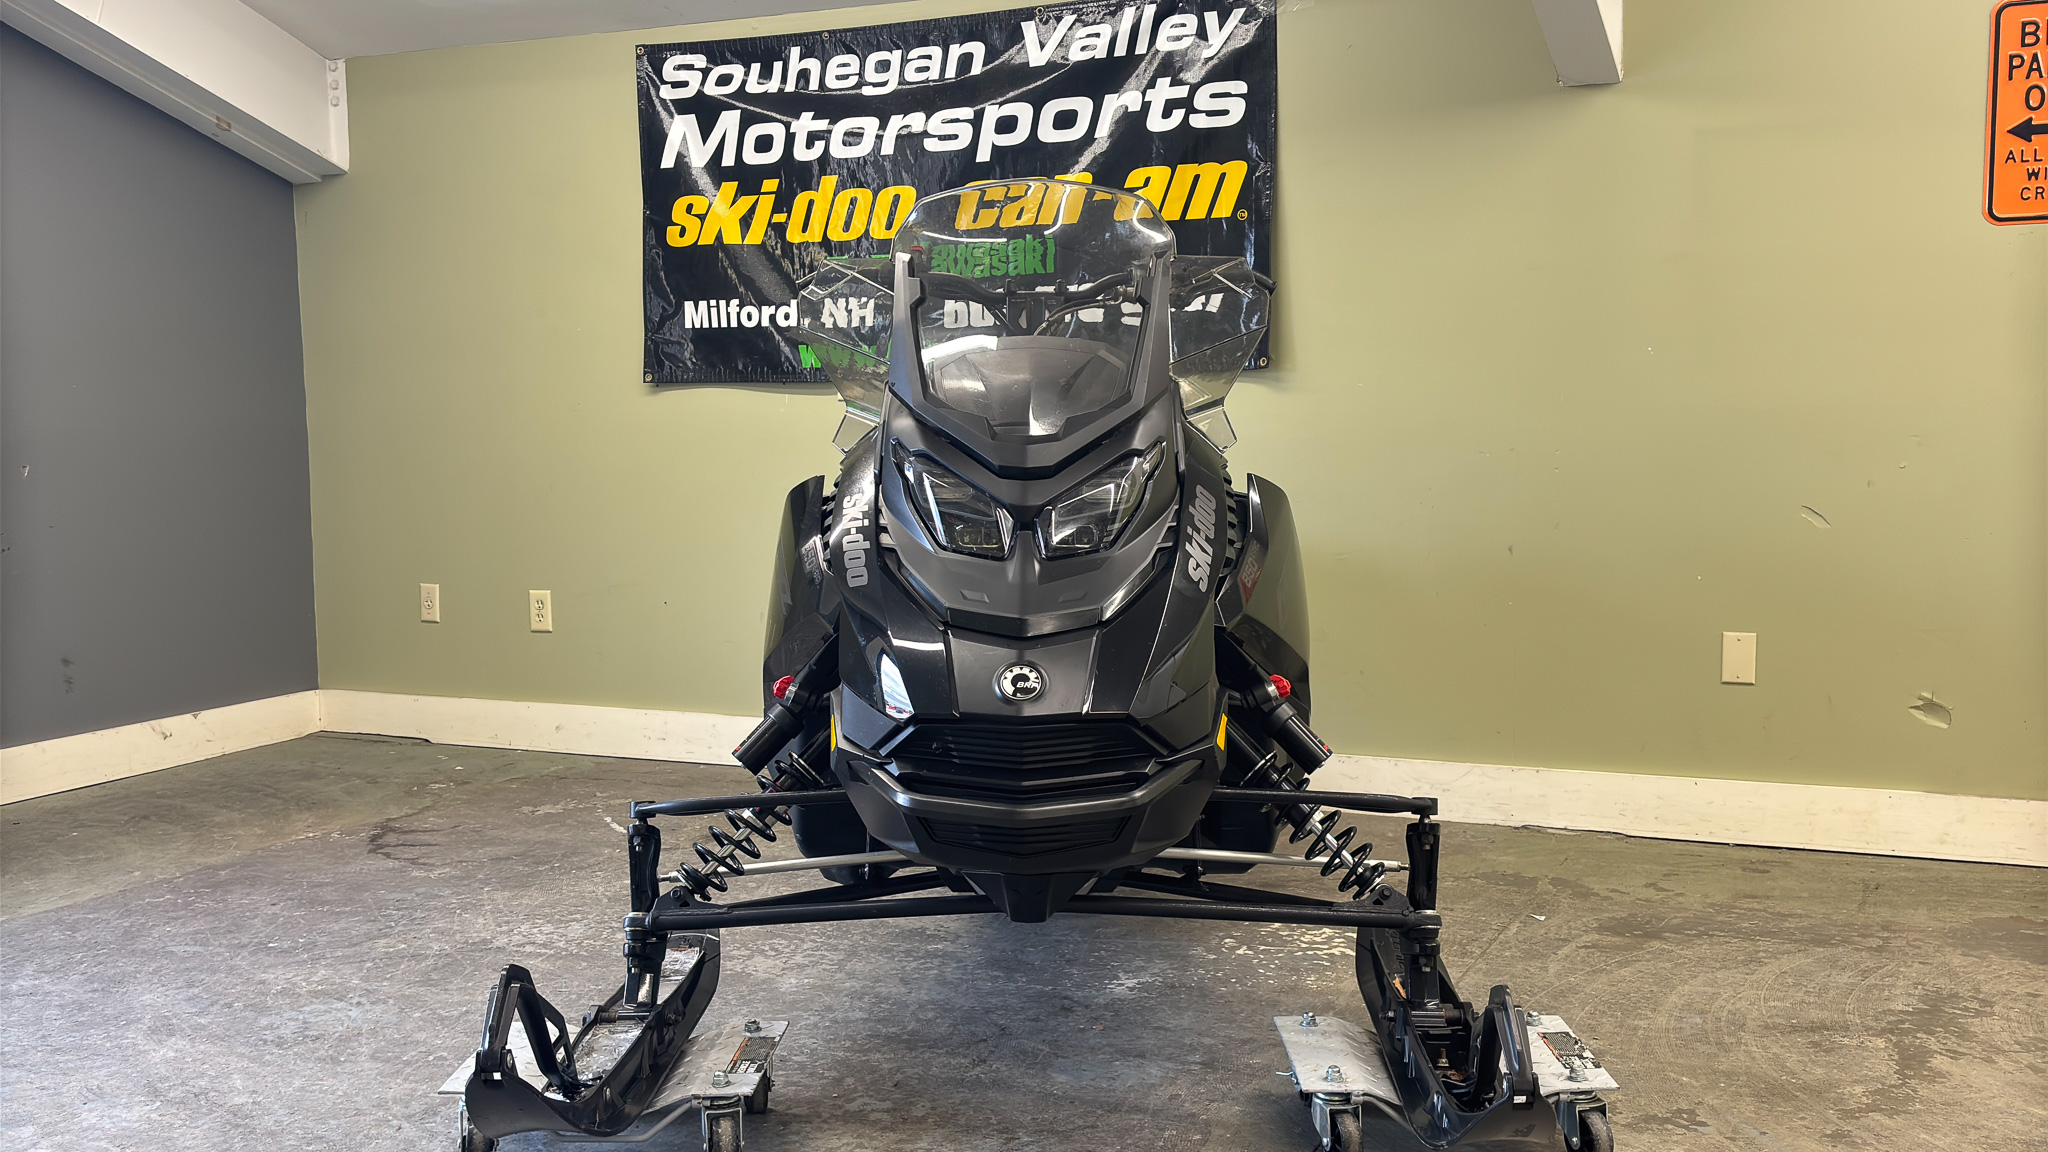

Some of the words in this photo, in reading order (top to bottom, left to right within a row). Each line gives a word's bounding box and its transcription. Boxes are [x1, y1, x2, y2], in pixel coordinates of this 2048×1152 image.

[659, 40, 986, 100] Souhegan
[1020, 4, 1246, 68] Valley
[660, 77, 1248, 169] Motorsports
[2004, 148, 2044, 164] ALL
[666, 175, 917, 248] ski-doo
[954, 160, 1248, 231] can-am
[820, 296, 876, 329] NH
[842, 493, 871, 588] ski-doo
[1185, 485, 1217, 593] ski-doo
